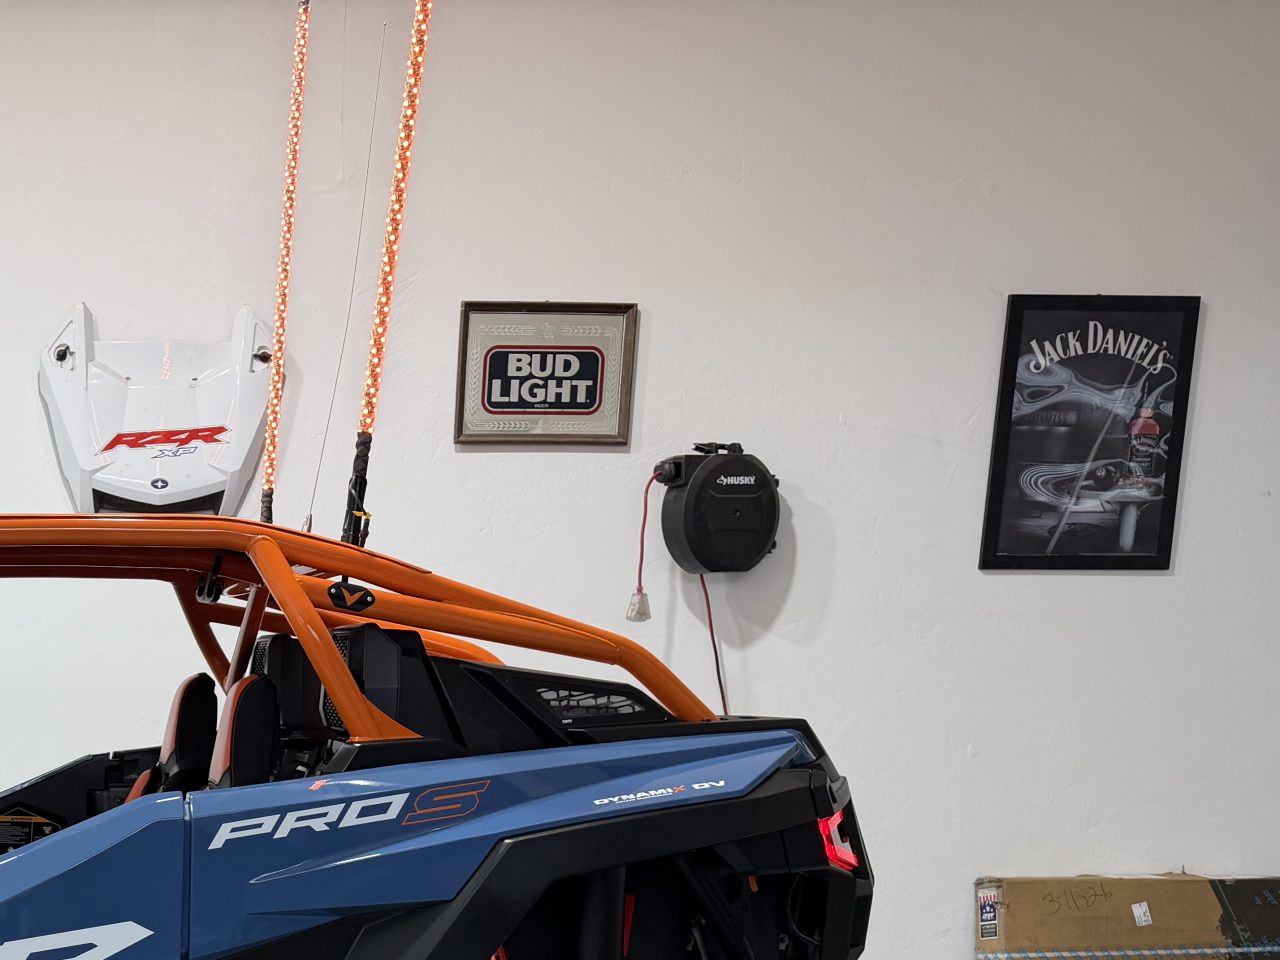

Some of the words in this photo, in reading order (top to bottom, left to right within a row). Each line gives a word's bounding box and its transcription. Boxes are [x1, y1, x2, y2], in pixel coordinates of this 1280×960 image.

[1029, 329, 1084, 374] JACK
[507, 353, 581, 378] BUD
[491, 378, 594, 403] LIGHT
[95, 425, 231, 456] RZR
[151, 446, 198, 459] XP
[727, 476, 756, 485] HUSKY
[593, 785, 686, 805] DYNAMIX
[692, 780, 725, 790] DV
[207, 791, 411, 851] PRO
[401, 779, 492, 826] S
